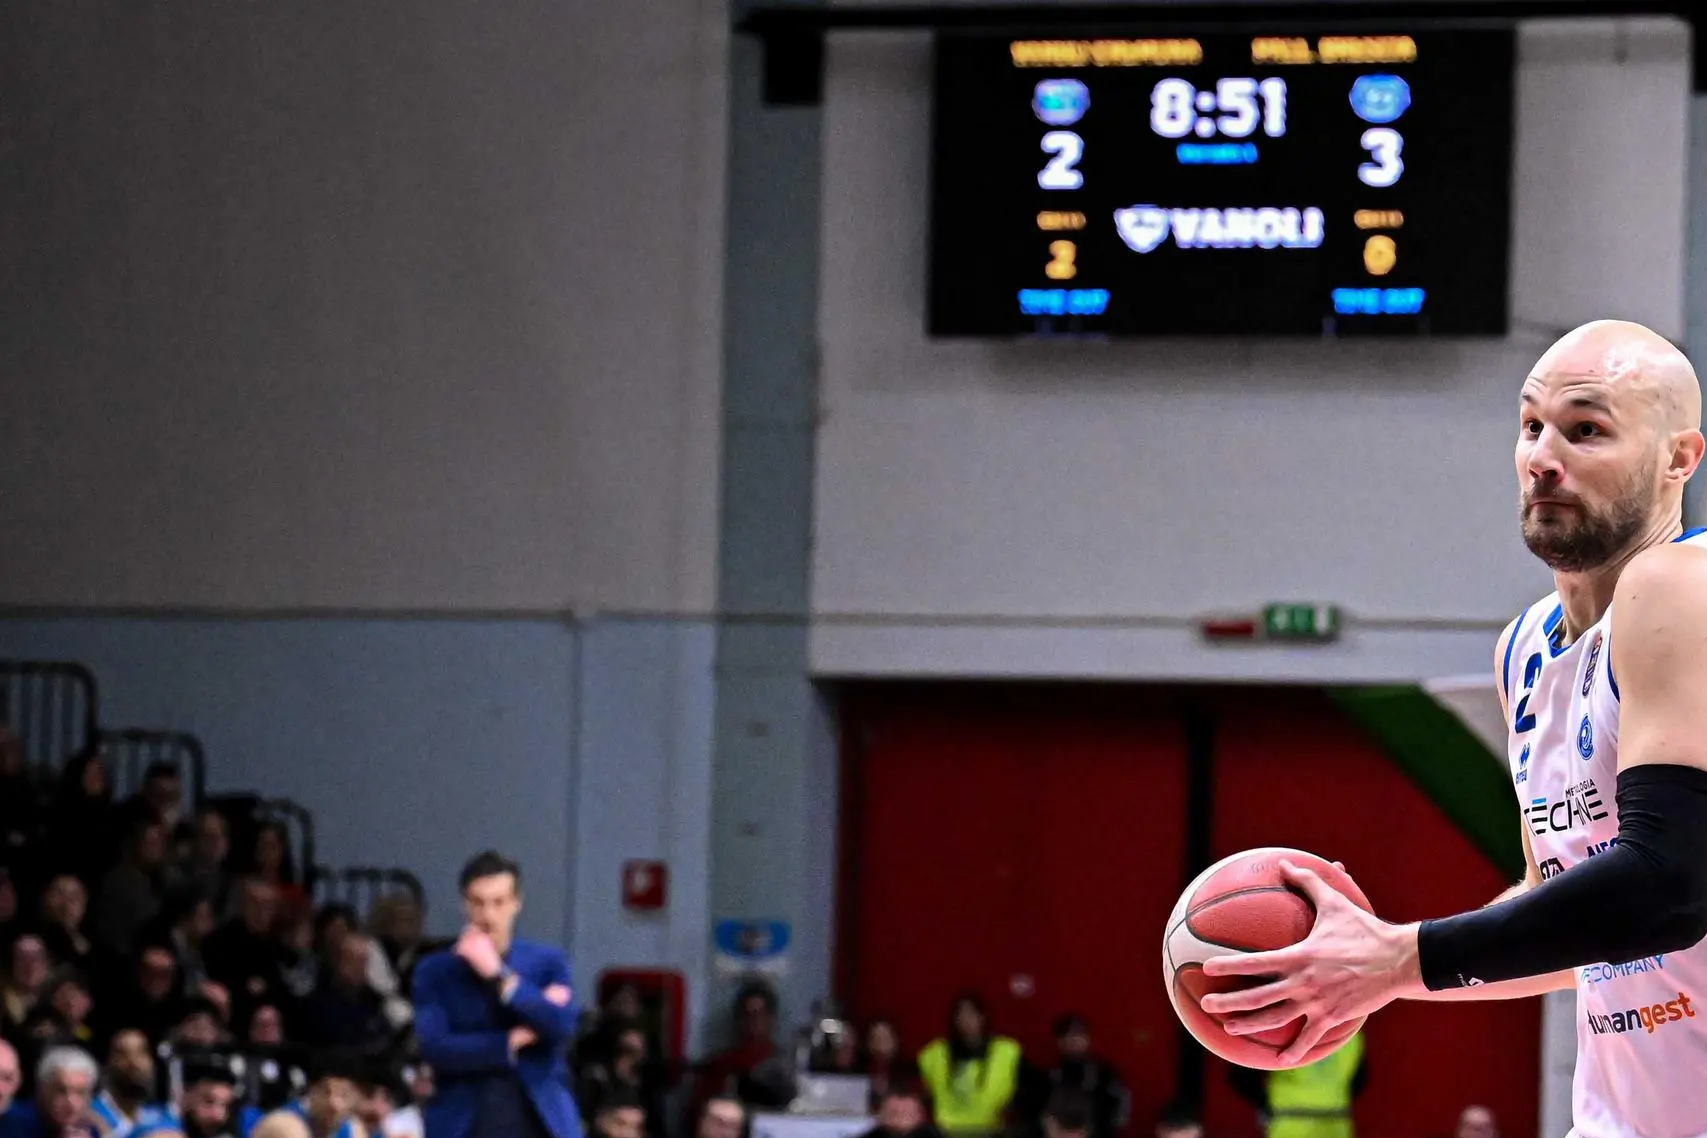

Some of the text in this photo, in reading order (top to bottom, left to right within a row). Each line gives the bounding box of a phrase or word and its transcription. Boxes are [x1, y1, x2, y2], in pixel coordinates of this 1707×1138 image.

[1150, 77, 1287, 138] 8:51
[1037, 130, 1084, 190] 2
[1357, 127, 1404, 187] 3
[1170, 206, 1324, 249] VANOLI
[1515, 651, 1543, 734] 2
[1590, 953, 1664, 983] COMPANY
